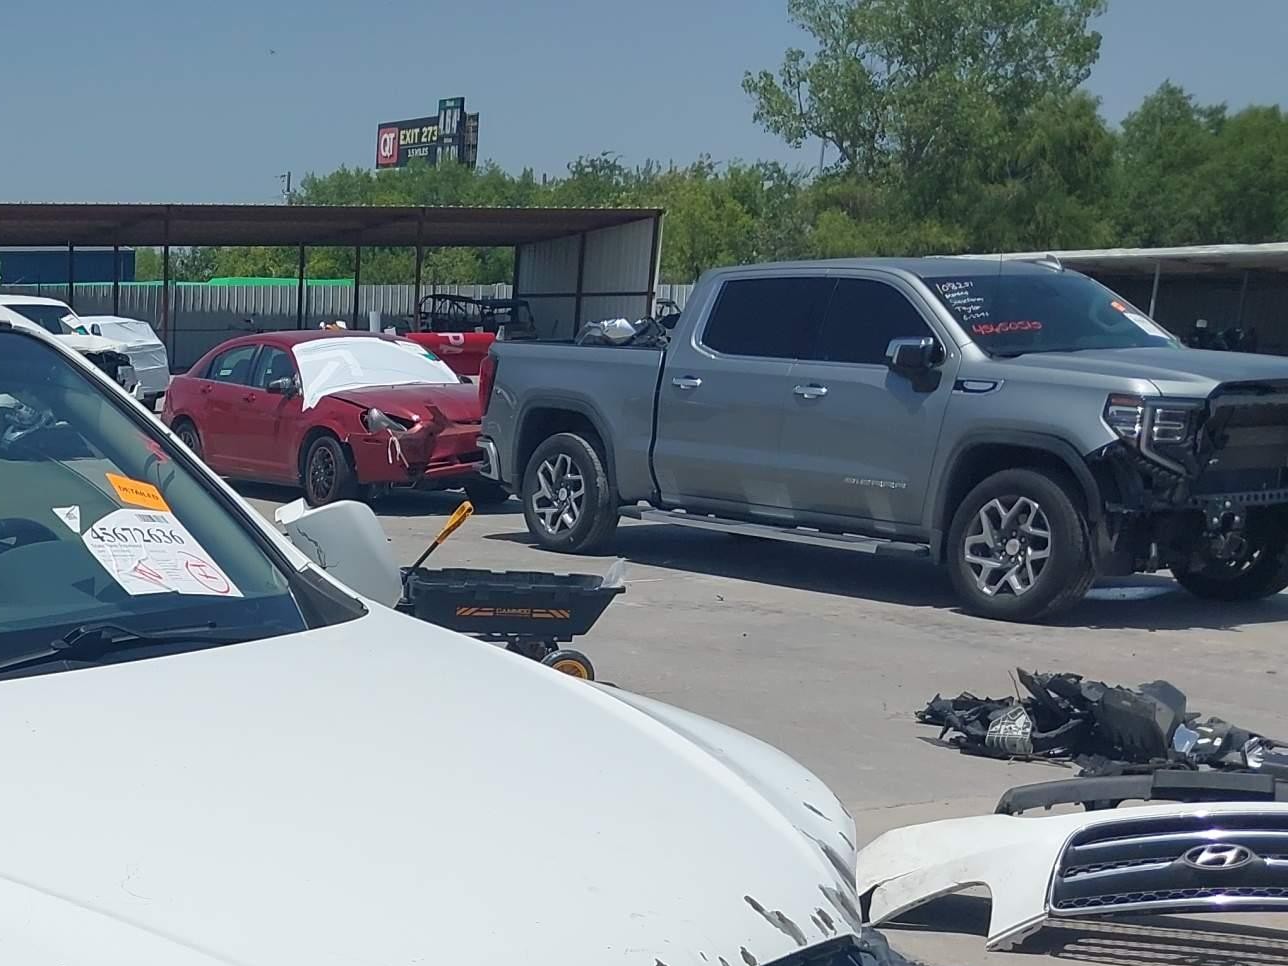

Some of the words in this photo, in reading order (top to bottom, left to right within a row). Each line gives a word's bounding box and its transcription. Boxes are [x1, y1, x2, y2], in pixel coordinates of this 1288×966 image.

[400, 128, 420, 145] EXIT
[422, 125, 438, 143] 273
[381, 133, 395, 158] QT
[117, 485, 160, 501] DETAILED
[91, 527, 185, 545] 45672636
